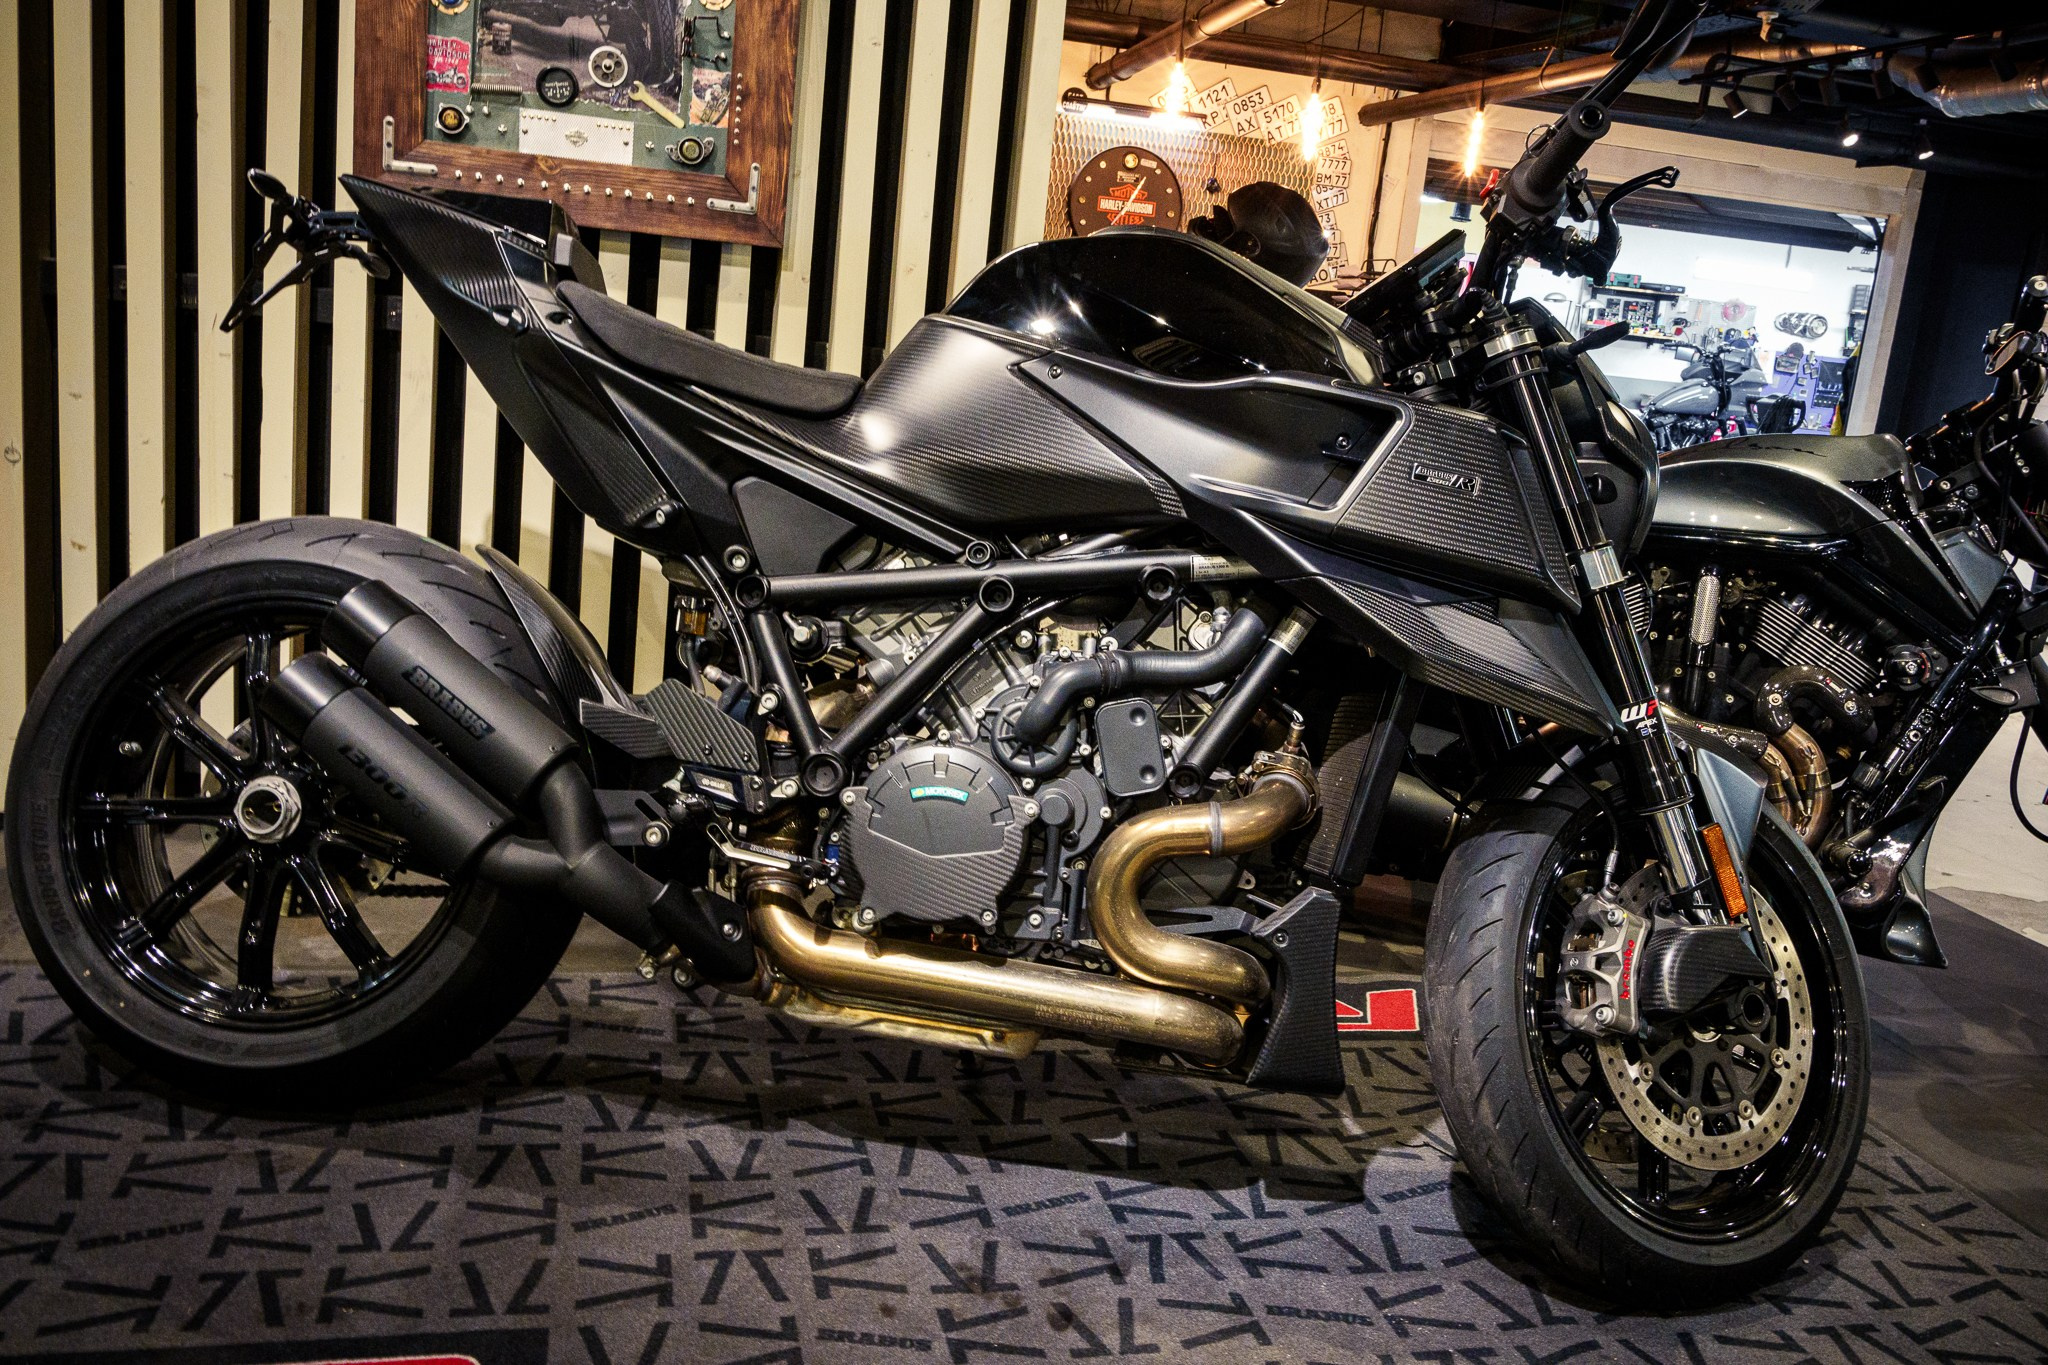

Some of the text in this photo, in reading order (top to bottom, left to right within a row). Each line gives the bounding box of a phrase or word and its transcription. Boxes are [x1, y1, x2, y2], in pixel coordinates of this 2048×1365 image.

[429, 46, 468, 60] DAVIDSON
[1199, 84, 1229, 109] 1121
[1233, 91, 1265, 116] 0853
[1263, 101, 1295, 124] 5170
[1237, 116, 1256, 136] AX
[1266, 125, 1283, 145] AT
[1329, 118, 1343, 135] 77
[1321, 158, 1347, 171] 7777
[1316, 172, 1347, 186] BM 77
[1113, 188, 1143, 199] MOTR
[1316, 191, 1345, 211] XT 77
[1416, 465, 1454, 481] BRABUS
[408, 666, 489, 739] BRABUS
[1620, 698, 1659, 723] WP
[925, 786, 968, 802] MOTOREX
[1619, 939, 1635, 1000] brembo
[1001, 1191, 1091, 1218] BRABUS
[572, 1203, 677, 1234] BRABUS
[78, 1219, 205, 1252] BRABUS
[1264, 1303, 1375, 1327] BRABUS
[815, 1327, 933, 1353] BRABUS
